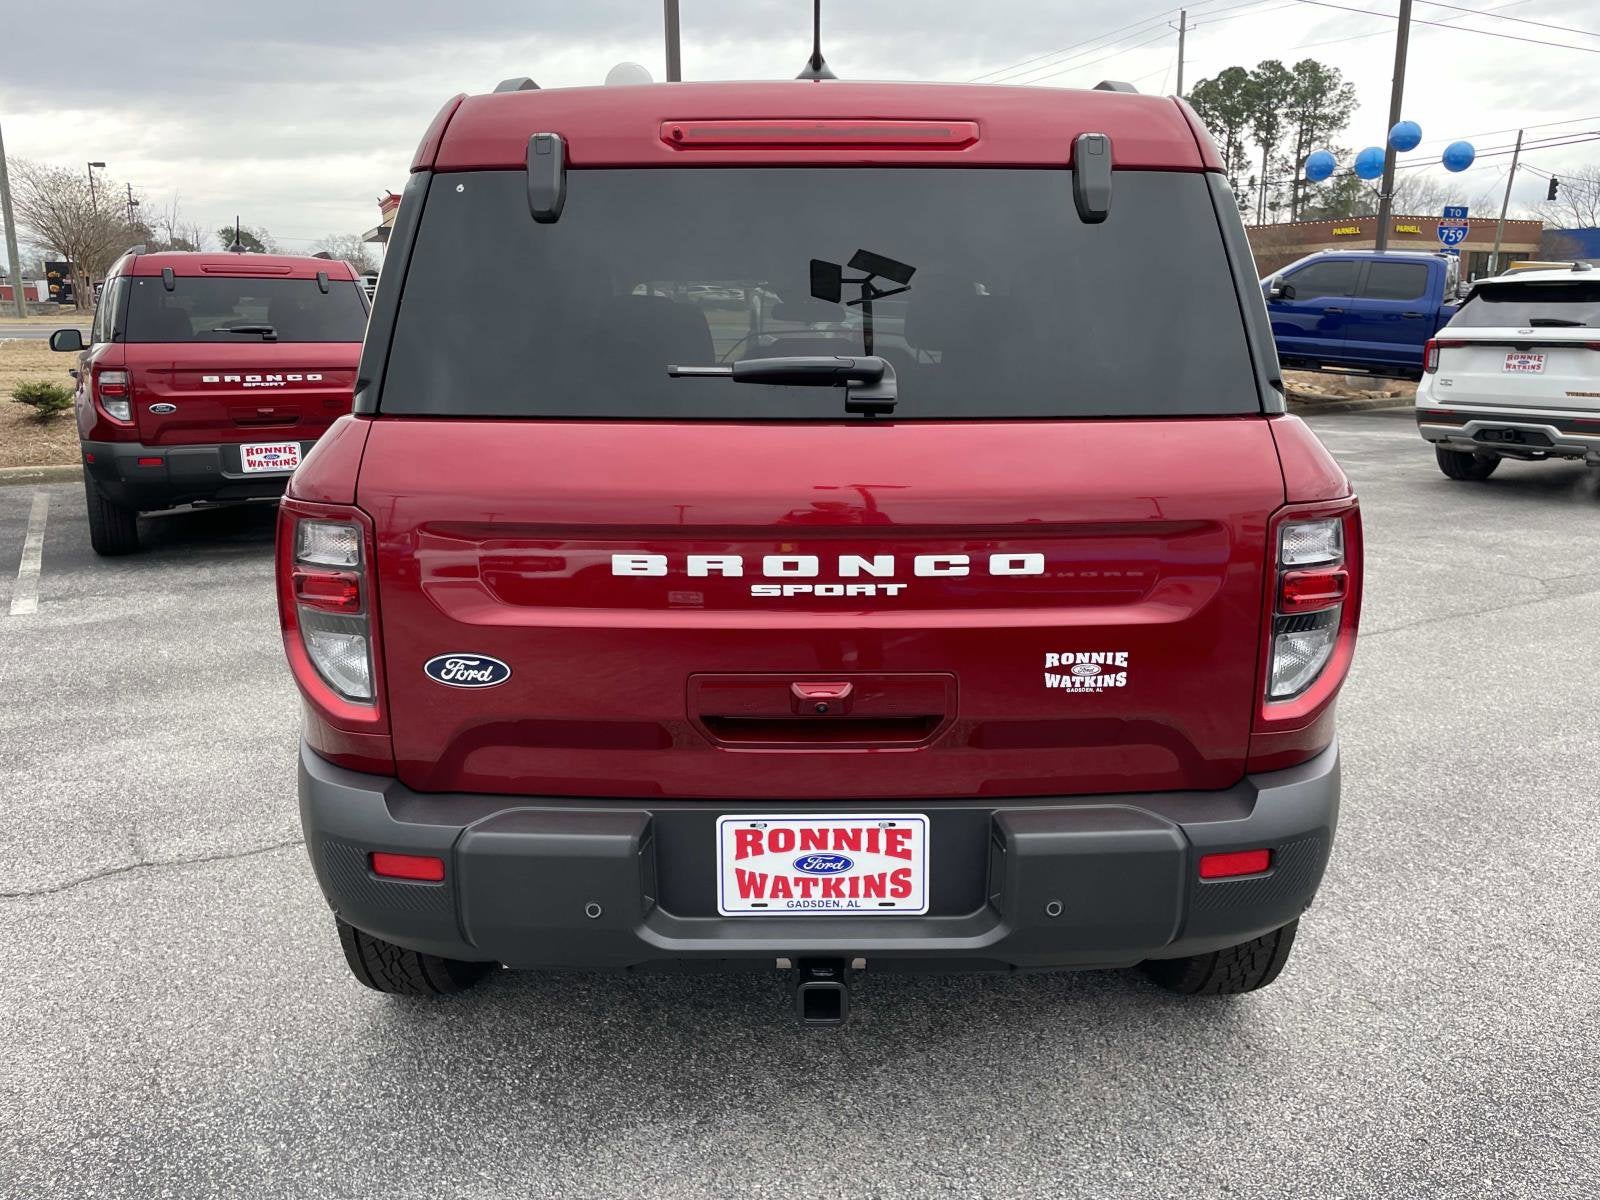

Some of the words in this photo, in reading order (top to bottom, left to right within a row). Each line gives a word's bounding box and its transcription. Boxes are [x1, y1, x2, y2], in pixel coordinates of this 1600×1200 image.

[1450, 208, 1462, 217] TO
[1332, 227, 1360, 235] PARNELL
[1396, 225, 1421, 233] PARNELL
[1442, 229, 1464, 242] 759
[1506, 354, 1544, 362] RONNIE
[1505, 362, 1542, 370] WATKINS
[202, 374, 322, 383] BRONCO
[245, 446, 297, 457] RONNIE
[246, 457, 298, 468] WATKINS
[611, 553, 1045, 577] BRONCO
[750, 583, 907, 597] SPORT
[1044, 651, 1129, 669] RONNIE
[441, 658, 494, 682] Ford
[1044, 671, 1128, 688] WATKINS
[734, 827, 913, 861] RONNIE
[802, 856, 845, 871] Ford
[734, 867, 913, 899] WATKINS
[786, 899, 844, 909] GADSDEN,
[846, 899, 861, 908] AL
